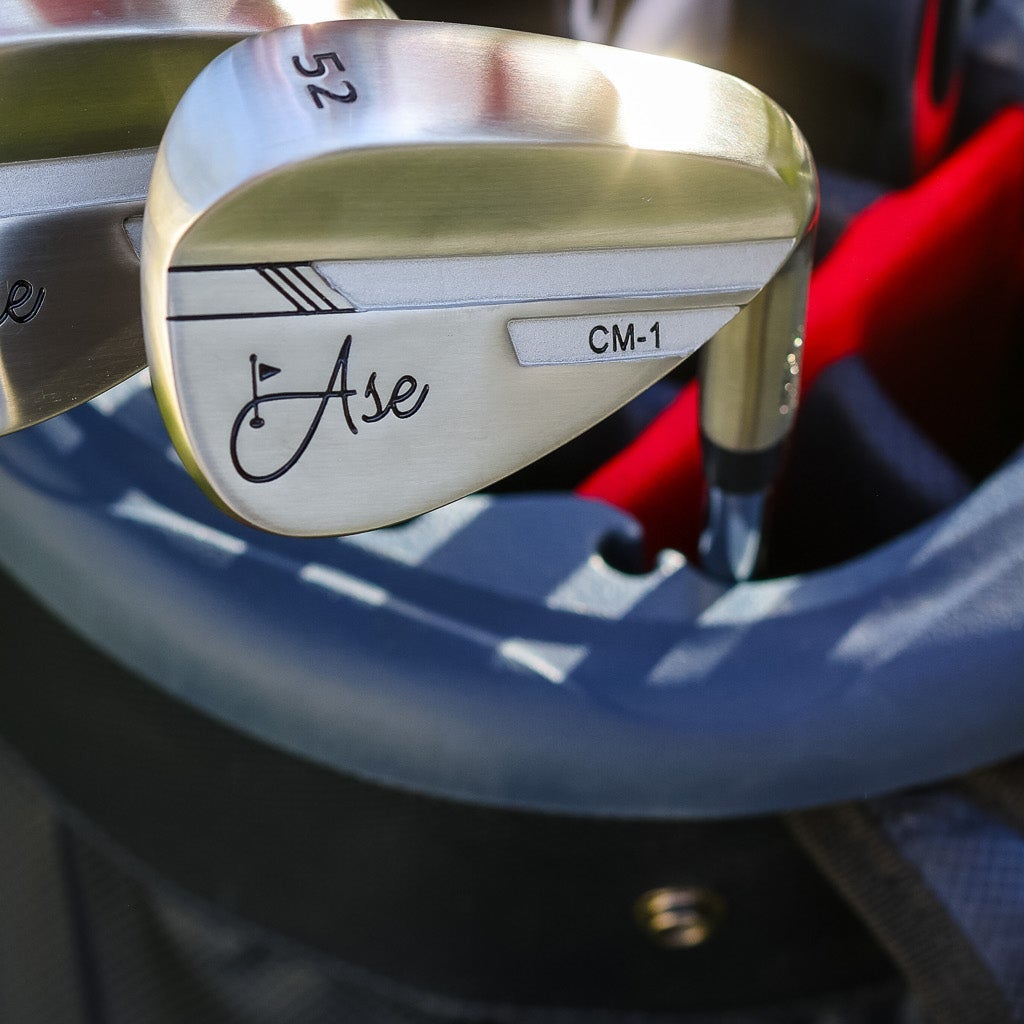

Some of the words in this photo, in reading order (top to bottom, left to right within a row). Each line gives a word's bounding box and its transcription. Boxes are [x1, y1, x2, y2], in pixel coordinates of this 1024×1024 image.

[291, 51, 359, 109] 52
[588, 321, 662, 355] CM-1
[229, 334, 430, 484] Ase
